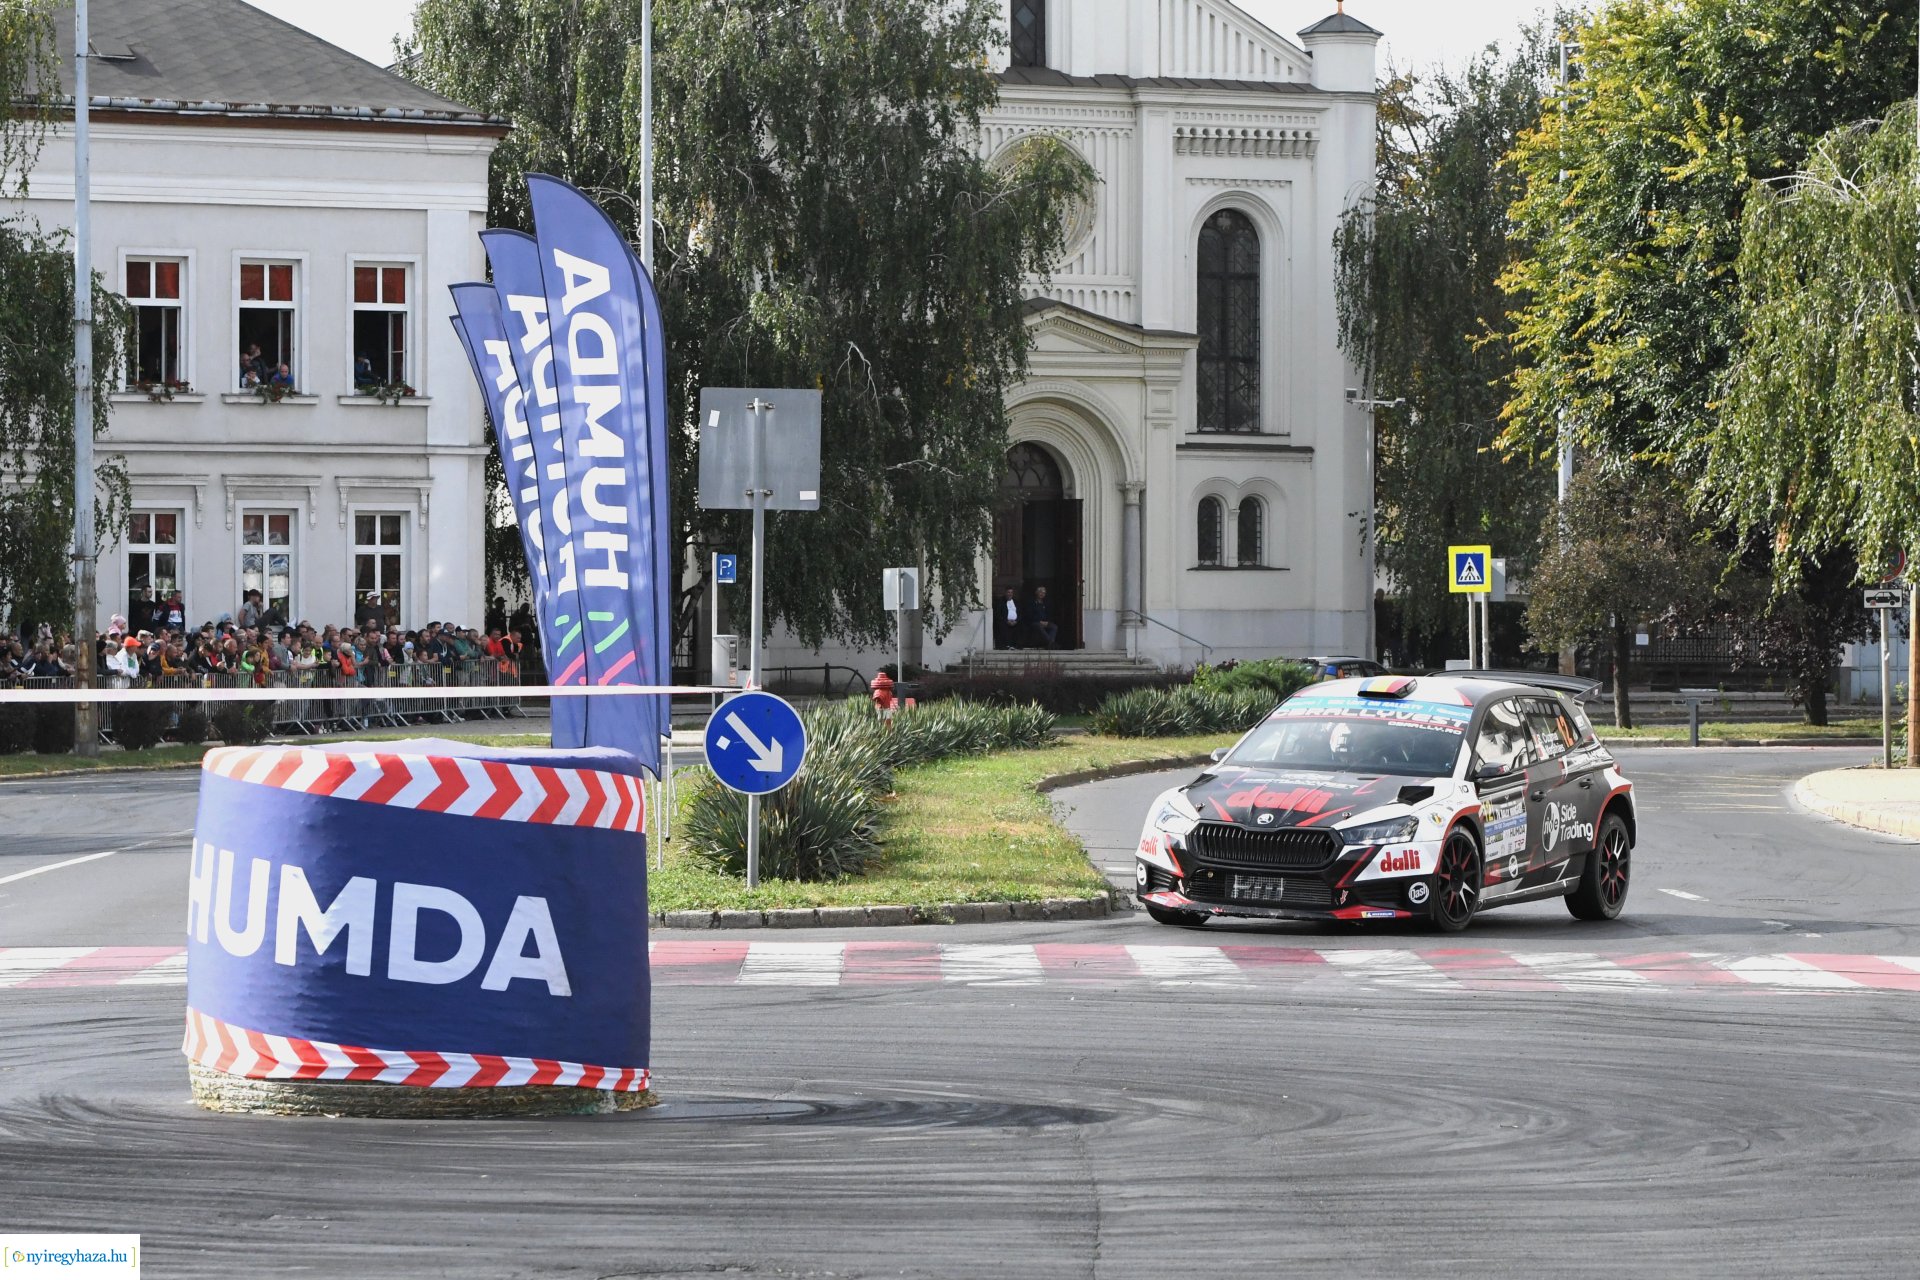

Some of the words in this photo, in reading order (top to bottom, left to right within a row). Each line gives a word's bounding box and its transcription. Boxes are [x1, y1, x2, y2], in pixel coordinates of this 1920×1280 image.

[1226, 785, 1334, 814] dalli
[1561, 803, 1577, 822] Side
[1560, 821, 1593, 842] Trading
[1141, 836, 1158, 856] dalli
[1380, 849, 1420, 872] dalli
[187, 838, 573, 997] HUMDA
